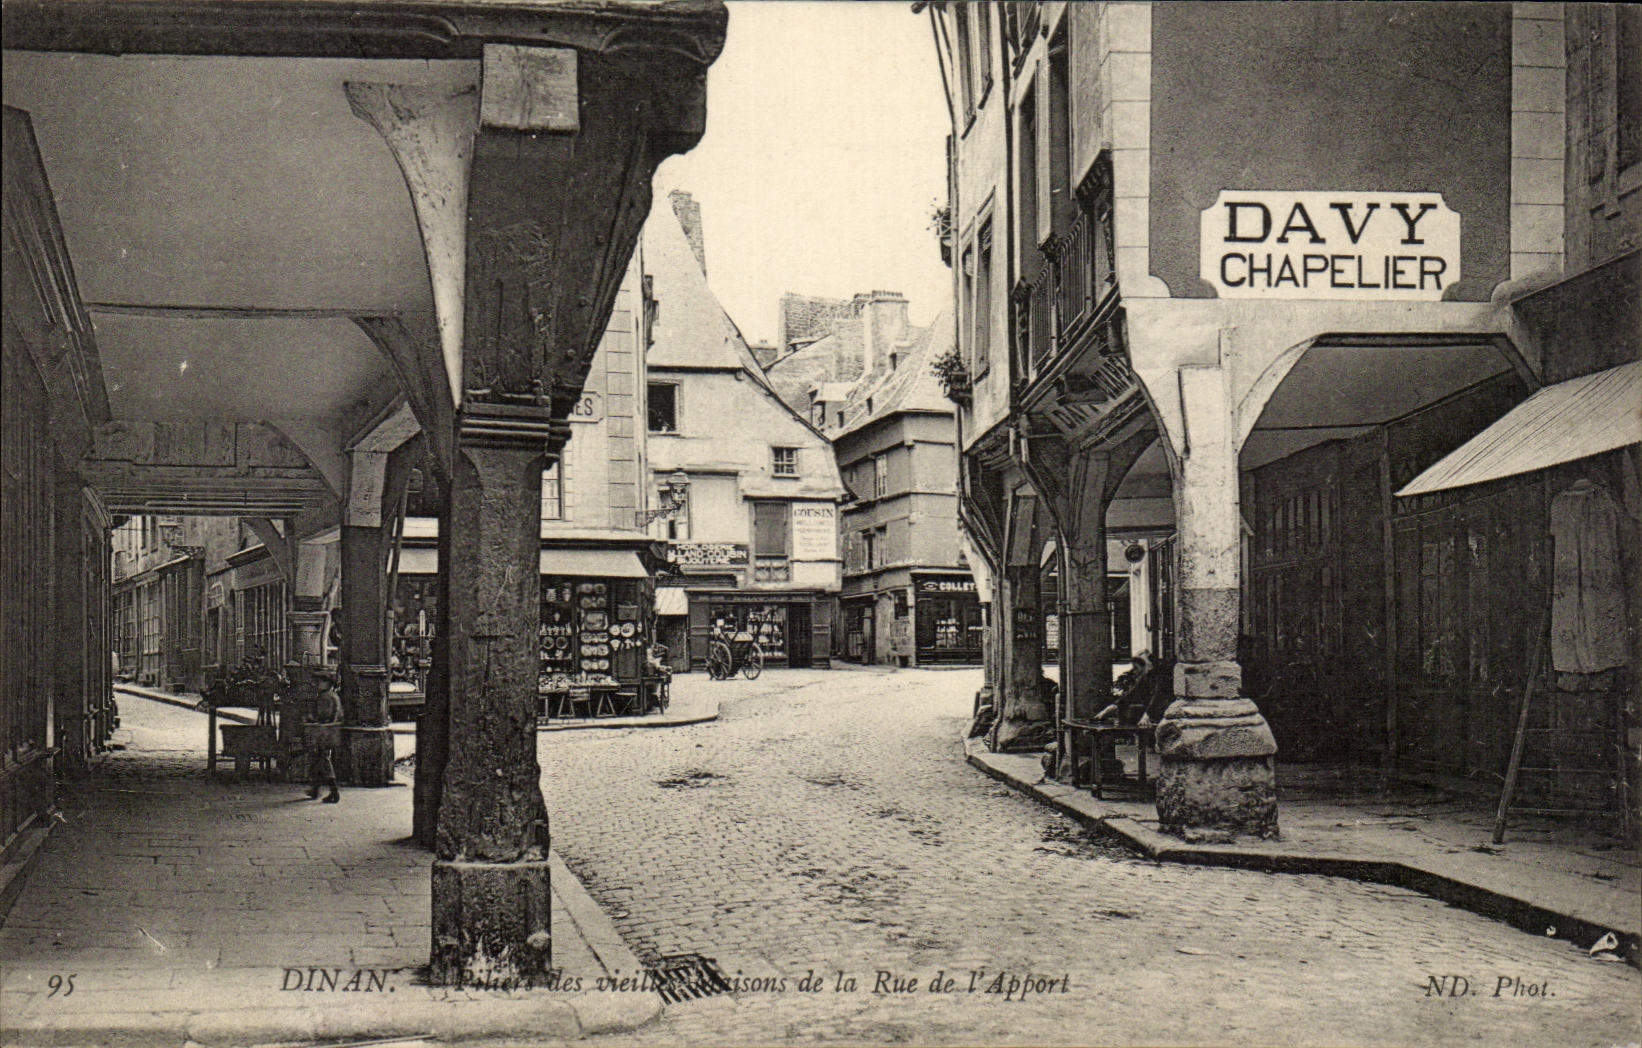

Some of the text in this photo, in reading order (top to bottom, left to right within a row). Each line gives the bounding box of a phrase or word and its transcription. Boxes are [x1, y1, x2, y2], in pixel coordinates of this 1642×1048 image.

[1223, 201, 1438, 245] DAVY
[1219, 252, 1448, 290] CHAPELIER
[575, 397, 594, 416] ES
[793, 508, 834, 518] COUSIN
